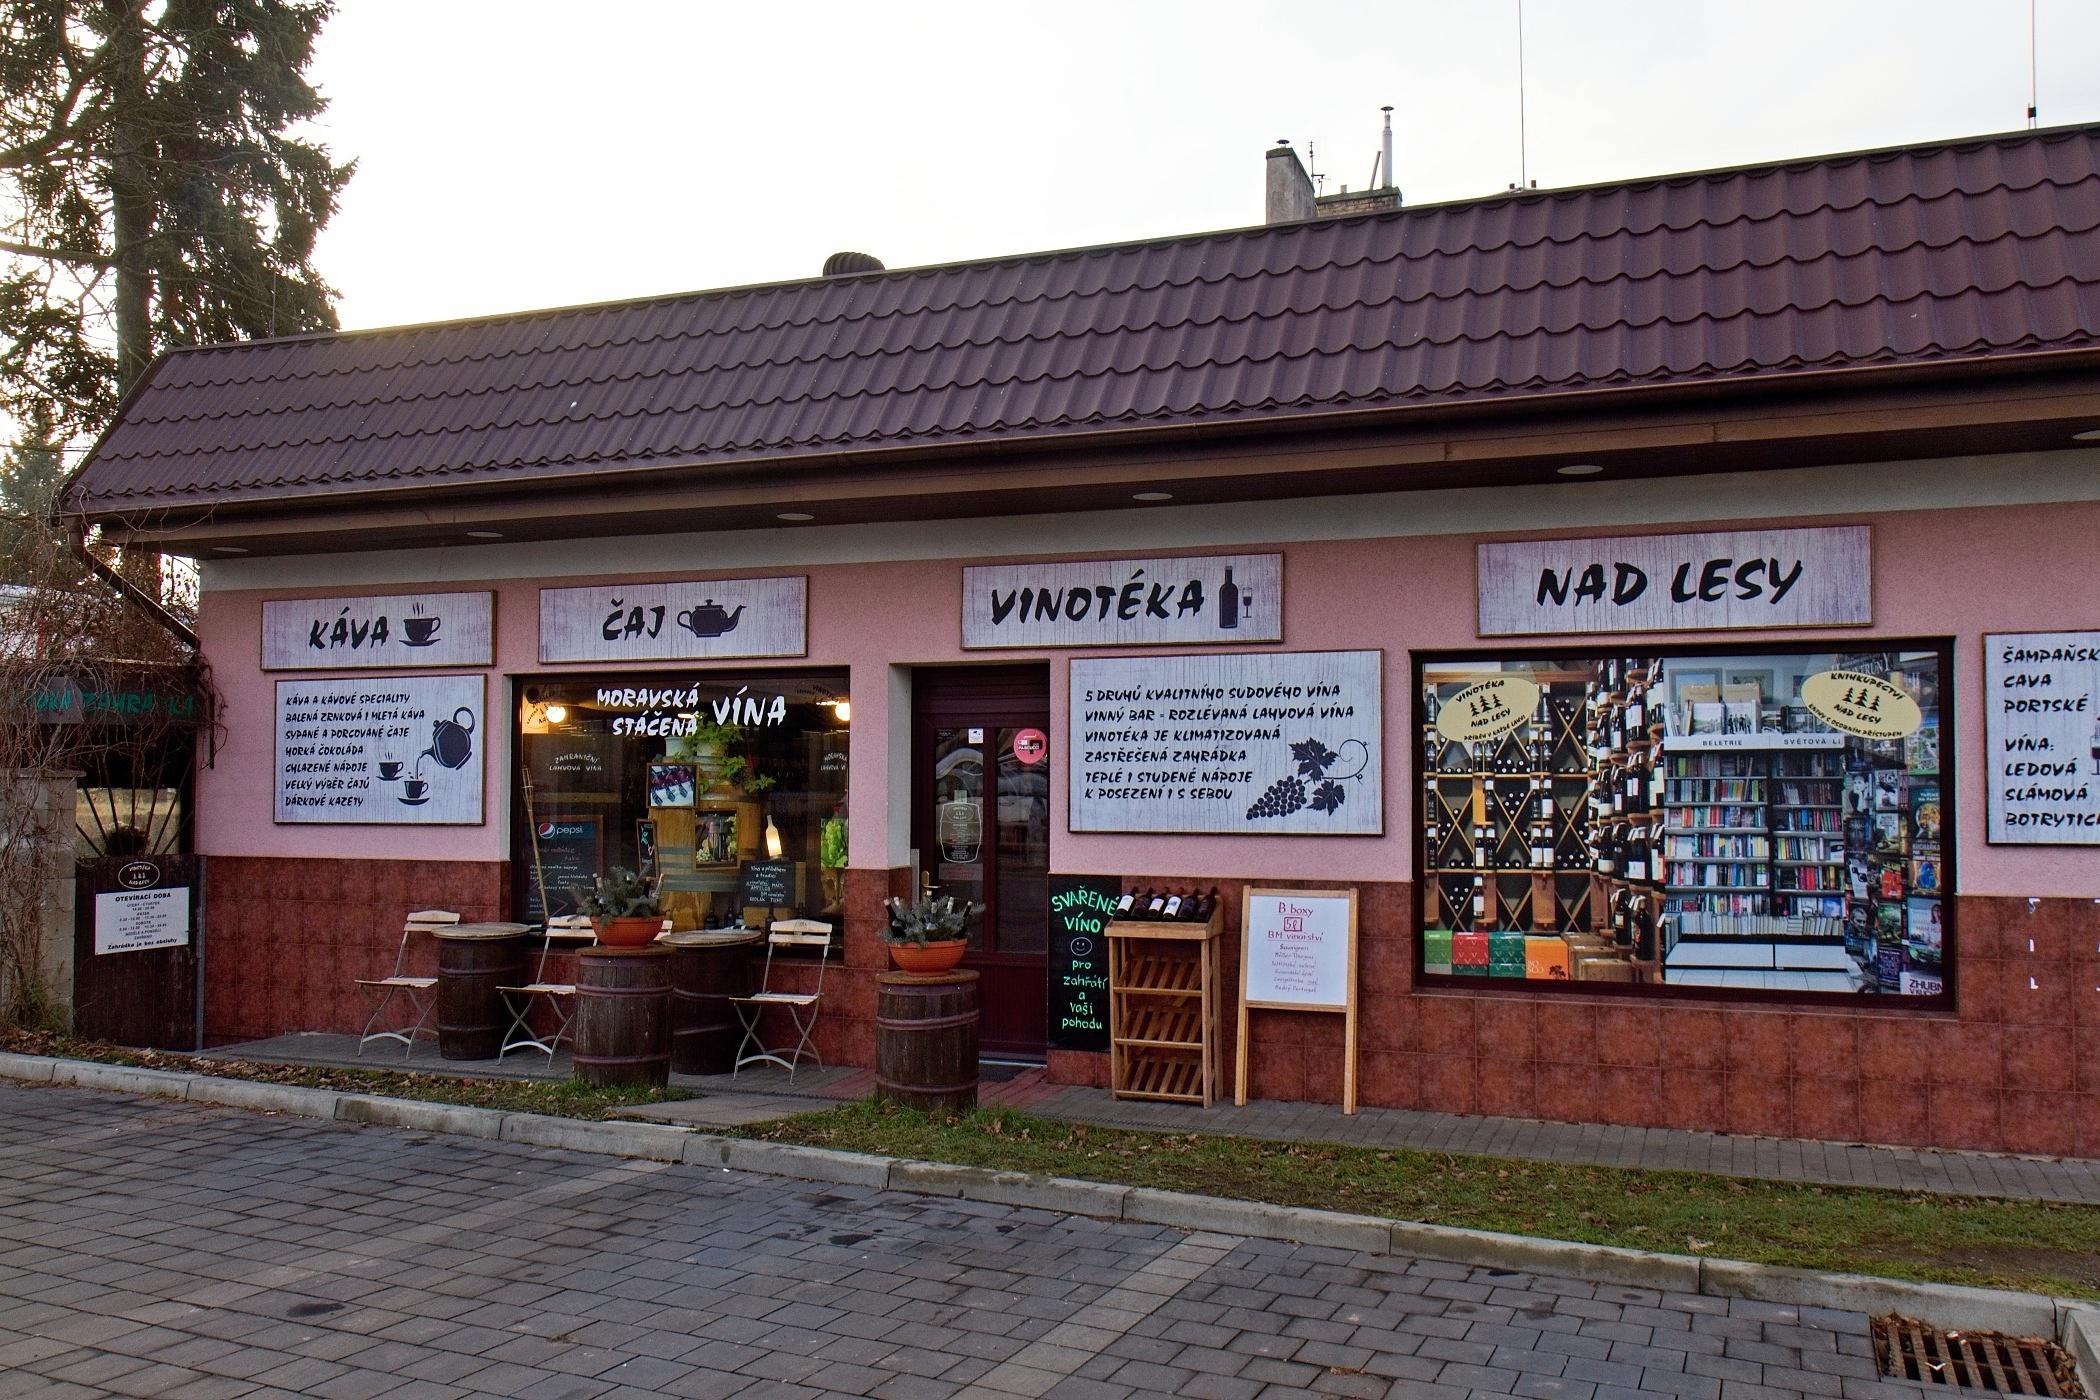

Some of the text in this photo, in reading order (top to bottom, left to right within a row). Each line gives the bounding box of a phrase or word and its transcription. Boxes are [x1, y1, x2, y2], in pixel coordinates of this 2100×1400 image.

[1536, 556, 1804, 607] NAD LESY
[990, 568, 1205, 626] VINOTÉKA
[602, 597, 666, 642] ČAJ
[309, 607, 390, 650] KÁVA
[1831, 672, 1907, 700] KNIHKUPECTVÍ
[2004, 673, 2052, 688] CAVA
[286, 692, 411, 706] KÁVA A KÁVOVÉ SPECIALITY
[597, 682, 700, 709] MORAVSKÁ
[1085, 680, 1341, 702] 5 DRUHŮ KVALITNÍHO SUDOVÉHO VÍNA
[1456, 680, 1505, 702] VINOTÉKA
[712, 685, 787, 728] VÍNA
[1085, 706, 1124, 722] VINNÝ
[1129, 709, 1155, 721] BAR
[1168, 703, 1248, 721] ROZLÉVANÁ
[1252, 702, 1315, 719] LAHVOVÁ
[1320, 702, 1354, 719] VÍNA
[1833, 704, 1854, 717] NAD
[2004, 693, 2089, 714] PORTSKÉ
[285, 709, 319, 722] BALENÁ
[320, 707, 364, 722] ZRNKOVÁ
[371, 707, 399, 720] MLETÁ
[401, 706, 425, 719] KÁVA
[1471, 707, 1511, 728] NAD LESY
[612, 709, 699, 737] STÁČENÁ
[285, 725, 410, 740] SYPANÉ A PORCOVANÉ ČAJE
[1085, 724, 1281, 743] VINOTÉKA JE KLIMATIZOVANÁ
[285, 742, 364, 756] HORKÁ ČOKOLÁDA
[1702, 739, 1744, 747] BELETRIE
[1783, 737, 1828, 746] SVĚTOVÁ
[2005, 733, 2055, 752] VÍNA:
[1085, 746, 1247, 763] ZASTŘEŠENÁ ZAHRÁDKA
[285, 760, 368, 774] CHLAZENÉ NÁPOJE
[1085, 766, 1253, 783] TEPLÉ I STUDENÉ NÁPOJE
[2005, 757, 2078, 777] LEDOVÁ
[285, 775, 370, 791] VELKÝ VÝBĚR ČAJŮ
[1085, 784, 1233, 800] K POSEZENÍ I S SEBOU
[2005, 782, 2089, 802] SLÁMOVÁ
[285, 794, 364, 808] DÁRKOVÉ KAZETY
[2006, 812, 2100, 829] BOTRYTIC
[556, 825, 584, 836] pepsi
[115, 893, 151, 902] OTEVÍRACÍ
[1051, 885, 1120, 917] SVAŘENÉ
[1278, 901, 1314, 918] B boxy
[1064, 911, 1101, 934] VÍNO
[1267, 930, 1283, 939] BM
[1072, 960, 1092, 971] pro
[1078, 991, 1086, 1000] a
[1062, 1017, 1103, 1030] pohodu
